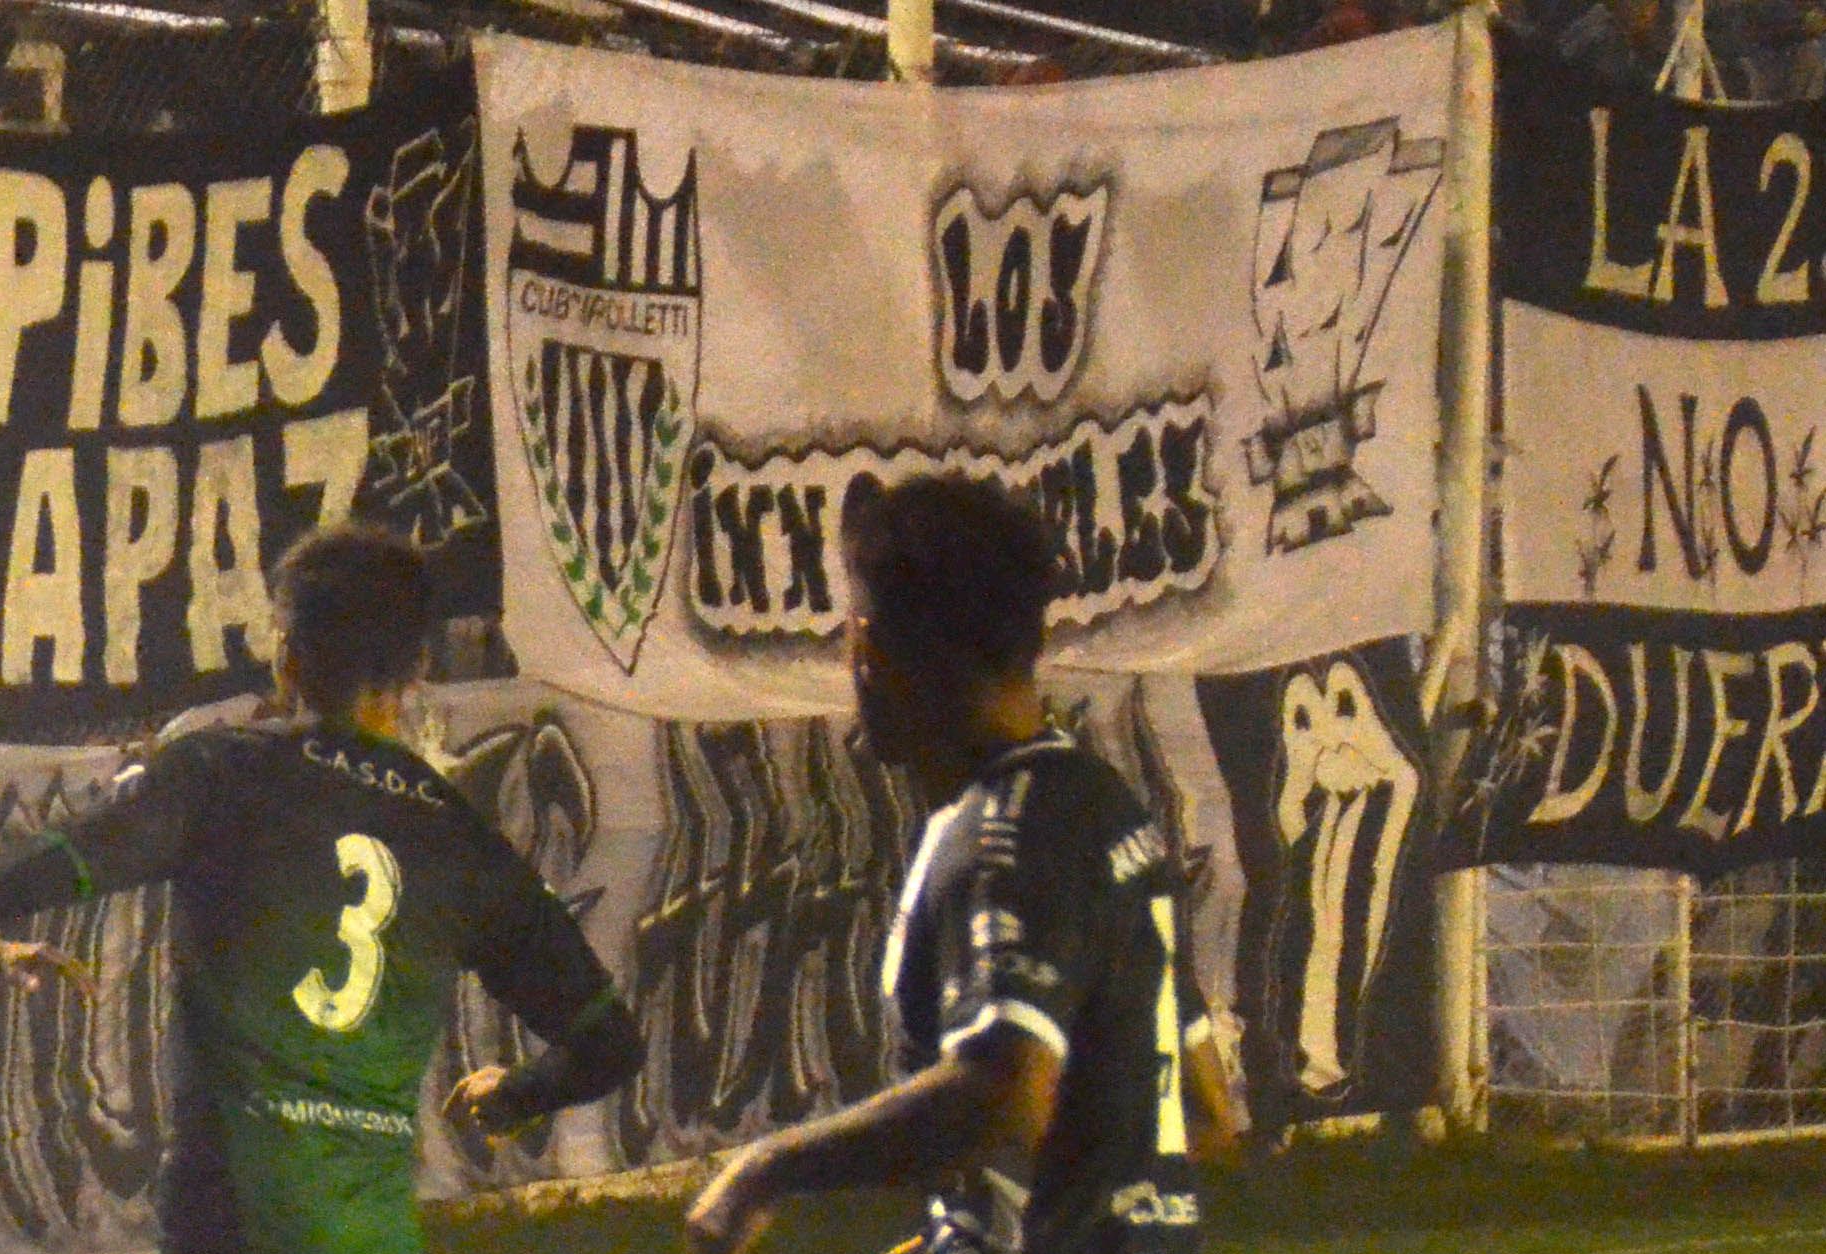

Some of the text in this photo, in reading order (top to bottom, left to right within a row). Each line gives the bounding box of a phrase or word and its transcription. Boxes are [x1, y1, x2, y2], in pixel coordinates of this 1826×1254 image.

[939, 210, 1092, 375] LOS
[1588, 106, 1826, 310] LA 2
[1637, 384, 1778, 582] NO
[1528, 640, 1826, 842] DUER
[292, 832, 402, 1033] 3
